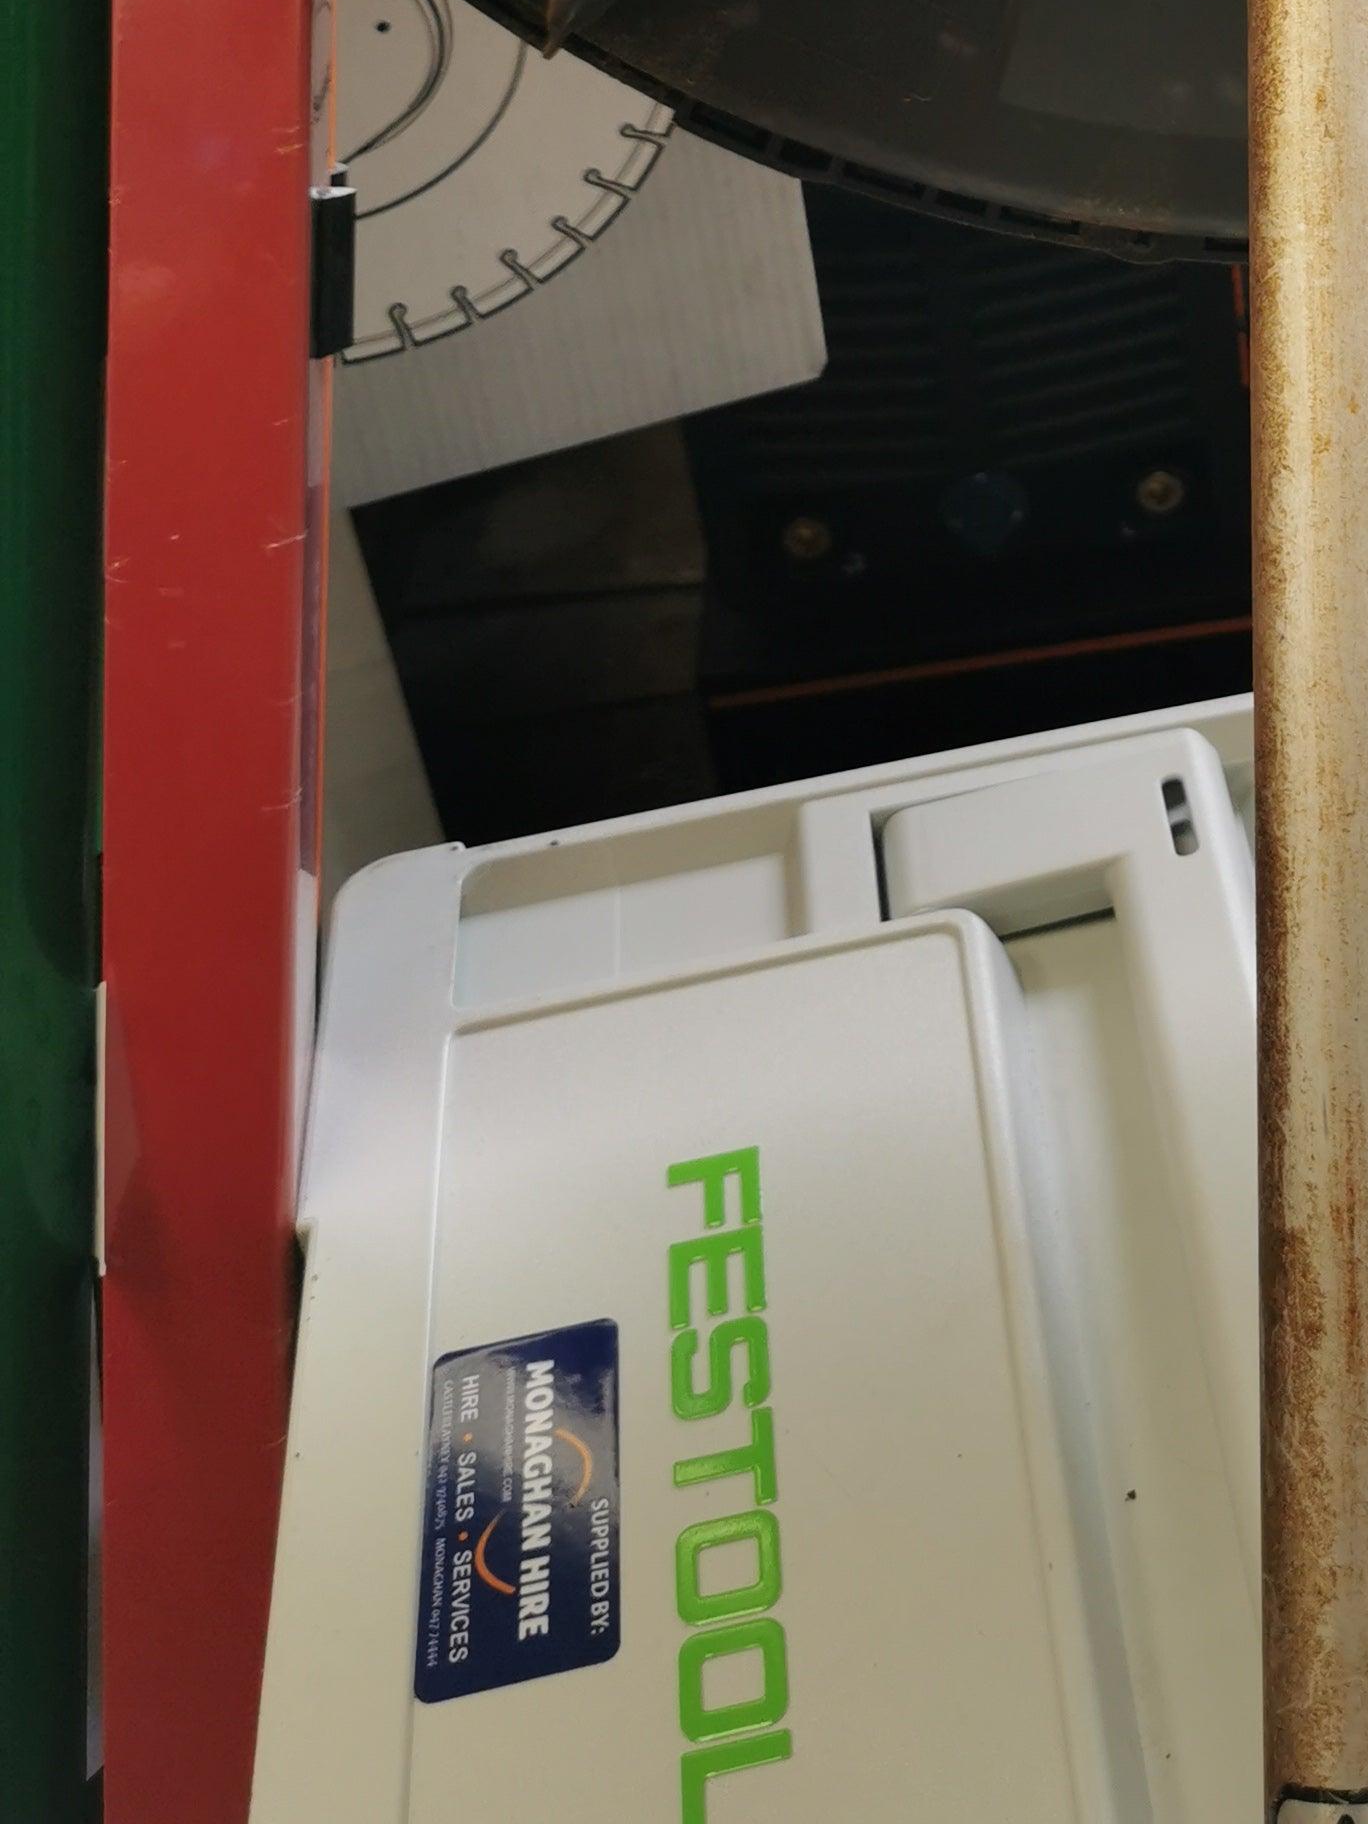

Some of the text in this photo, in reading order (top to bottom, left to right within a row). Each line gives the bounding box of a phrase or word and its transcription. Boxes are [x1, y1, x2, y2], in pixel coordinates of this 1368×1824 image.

[431, 1537, 446, 1608] MONAGHAN
[448, 1374, 480, 1664] HIRE SALES SERVICES
[518, 1359, 555, 1641] MONAGHAN HIRE
[590, 1497, 611, 1635] SUPPLIED BY:
[667, 1145, 793, 1824] FESTOOL
